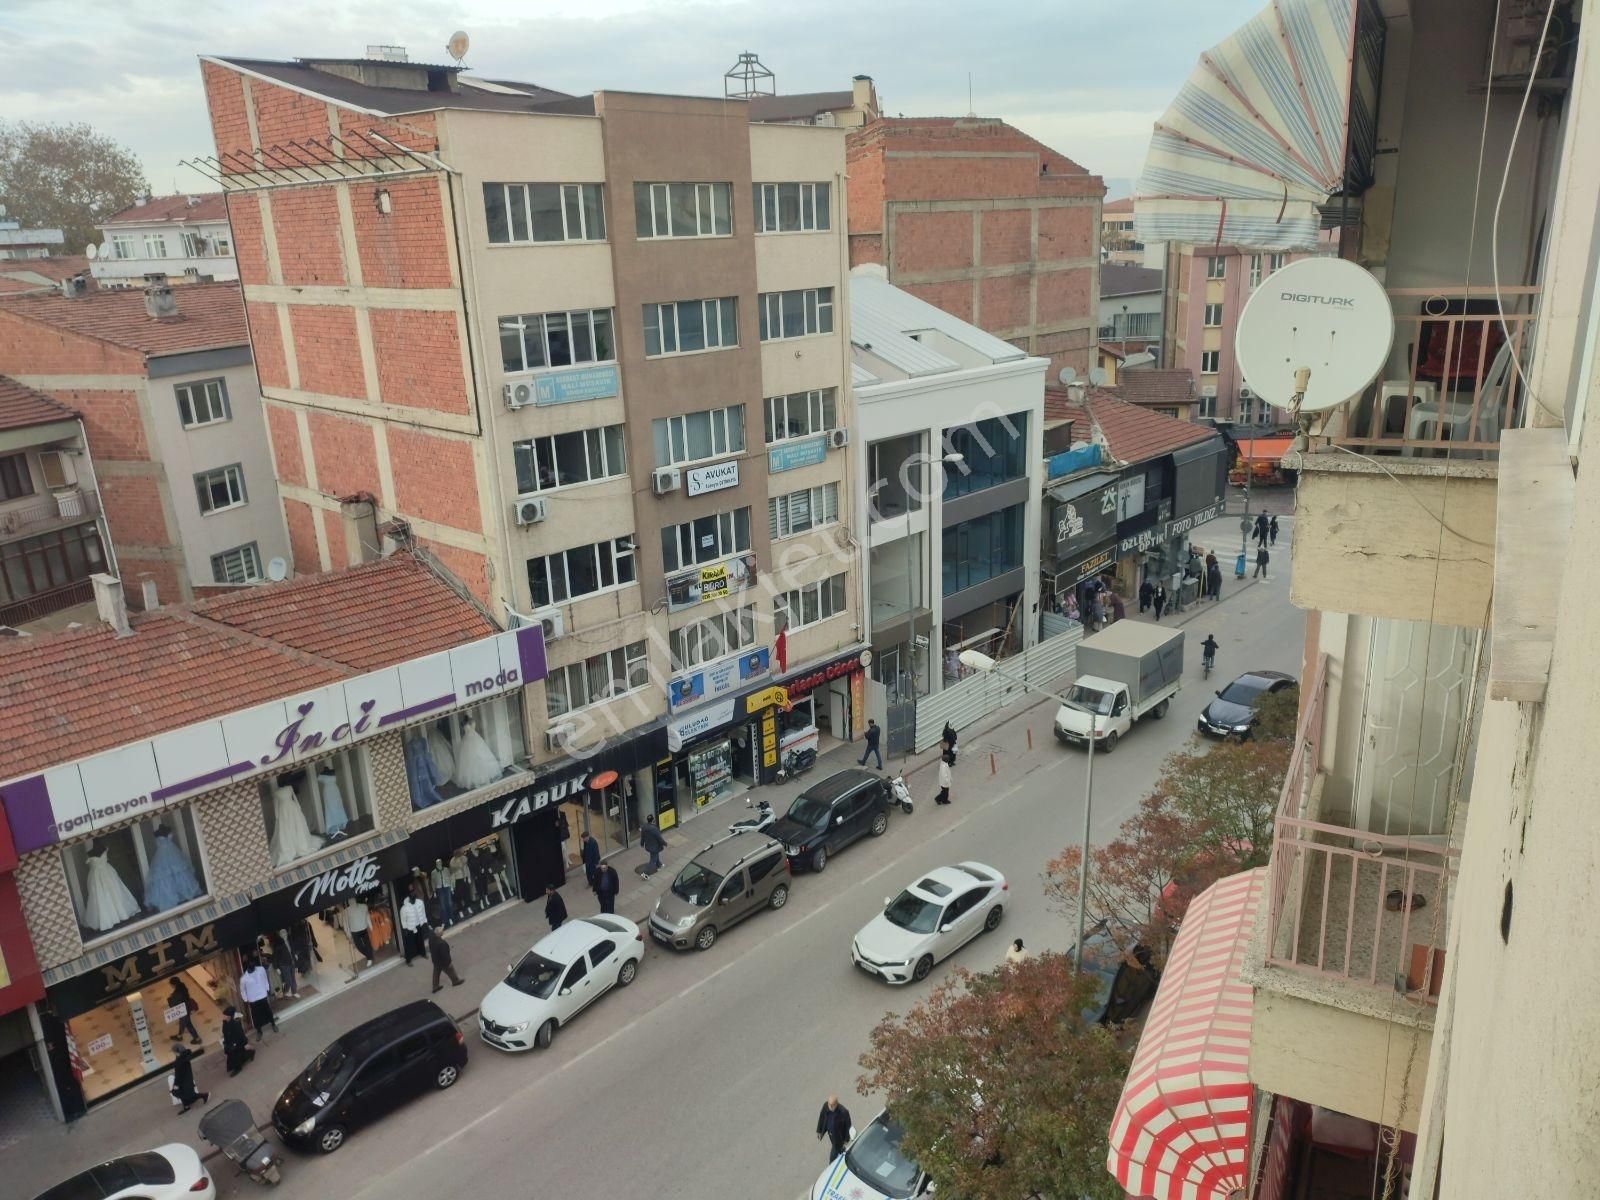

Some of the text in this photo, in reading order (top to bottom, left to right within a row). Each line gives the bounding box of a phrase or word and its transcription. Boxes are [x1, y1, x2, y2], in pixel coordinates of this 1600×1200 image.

[1280, 292, 1356, 307] DIGITURK
[705, 465, 736, 480] AVUKAT
[1172, 517, 1192, 536] FOTO
[1194, 507, 1217, 527] YILDIZ
[1121, 530, 1151, 552] ÖZLEM
[465, 668, 518, 697] moda
[491, 773, 588, 828] KABUK
[294, 856, 381, 908] Motto
